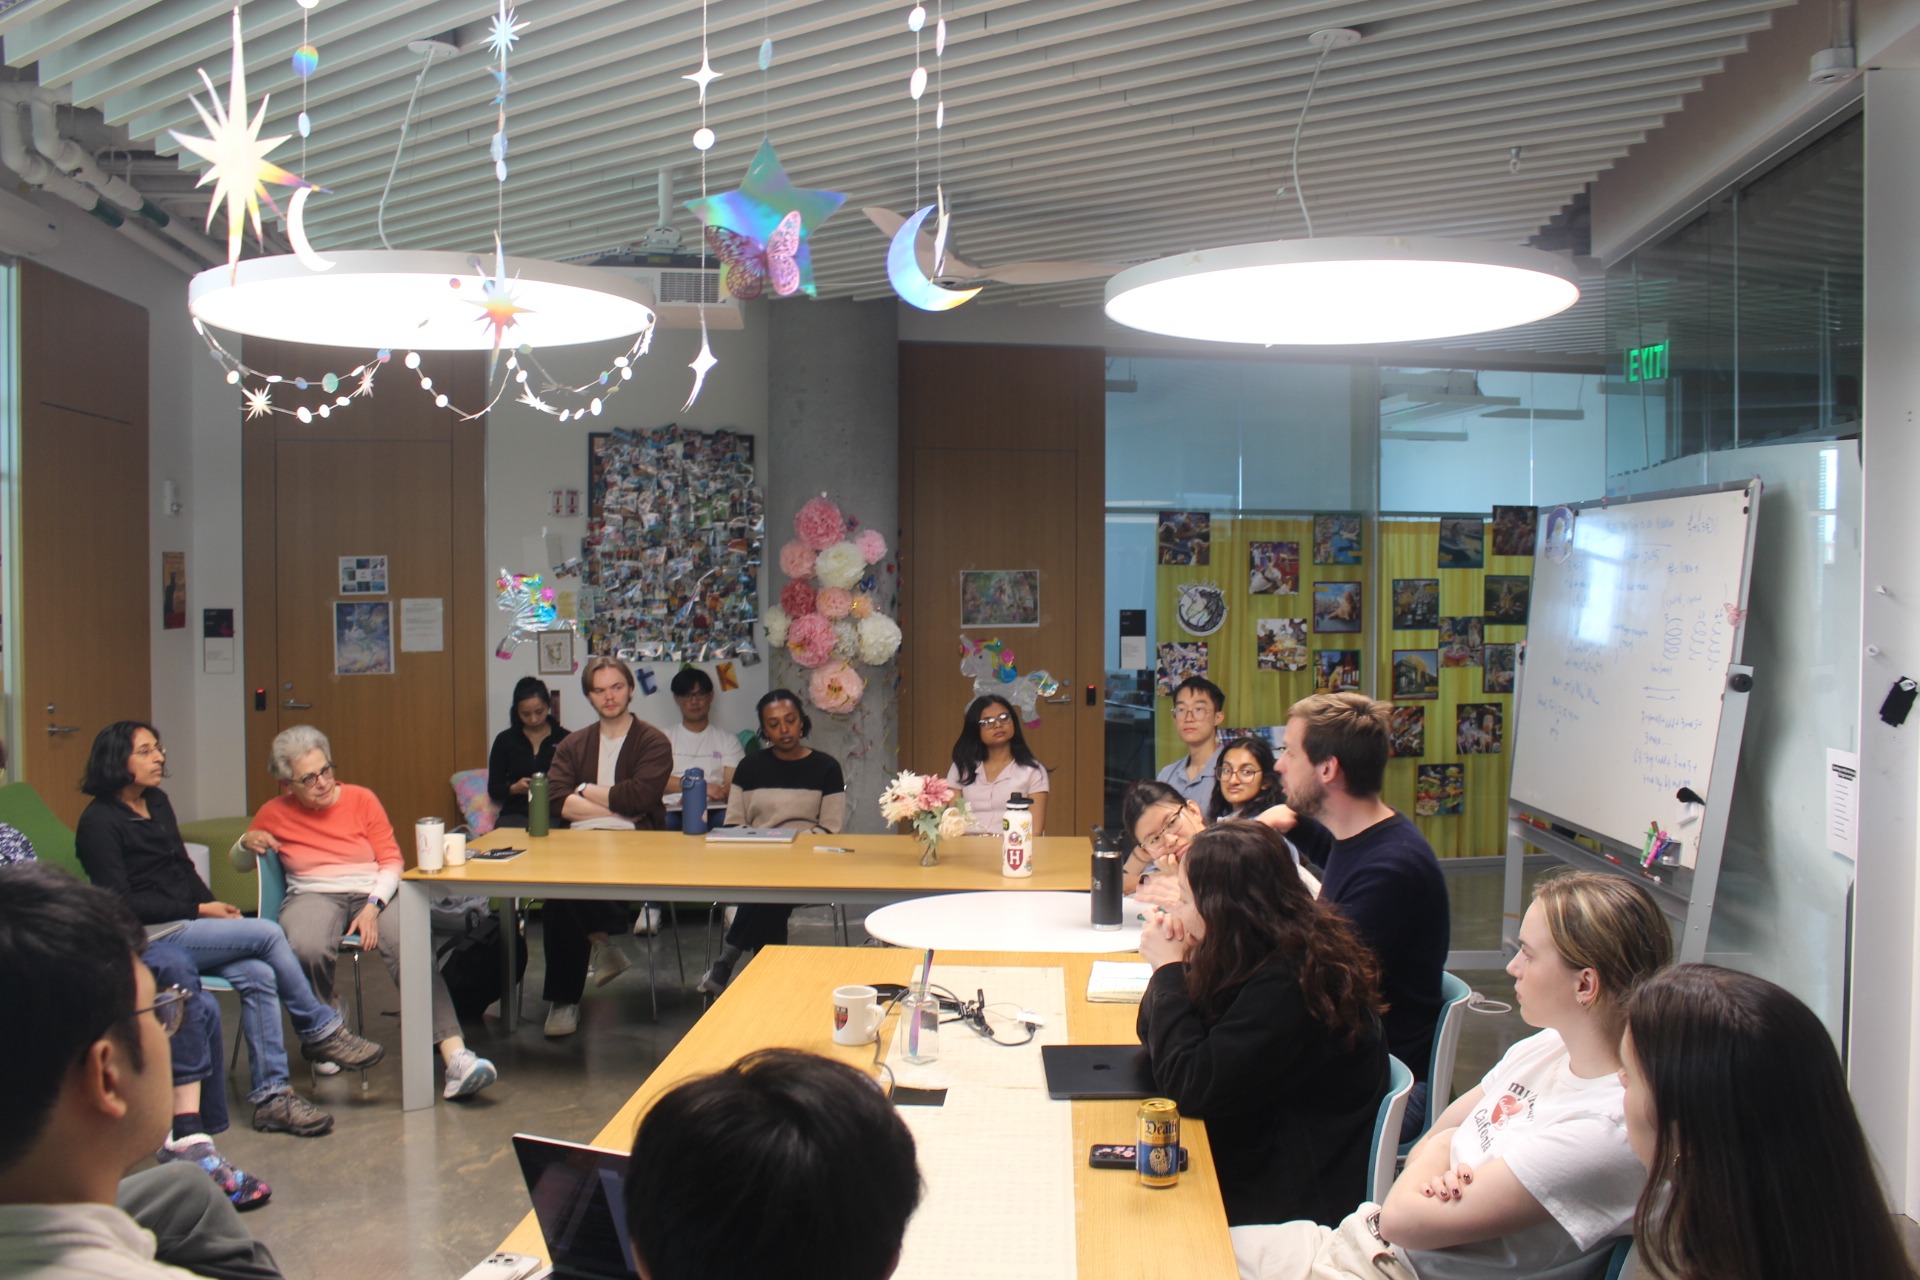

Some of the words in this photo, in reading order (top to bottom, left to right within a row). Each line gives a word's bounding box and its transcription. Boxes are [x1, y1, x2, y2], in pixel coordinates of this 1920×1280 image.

[1629, 344, 1664, 382] EXIT
[1009, 850, 1020, 865] H
[1508, 1082, 1530, 1101] my
[1145, 1120, 1177, 1135] Death
[1474, 1109, 1494, 1152] Calfonia
